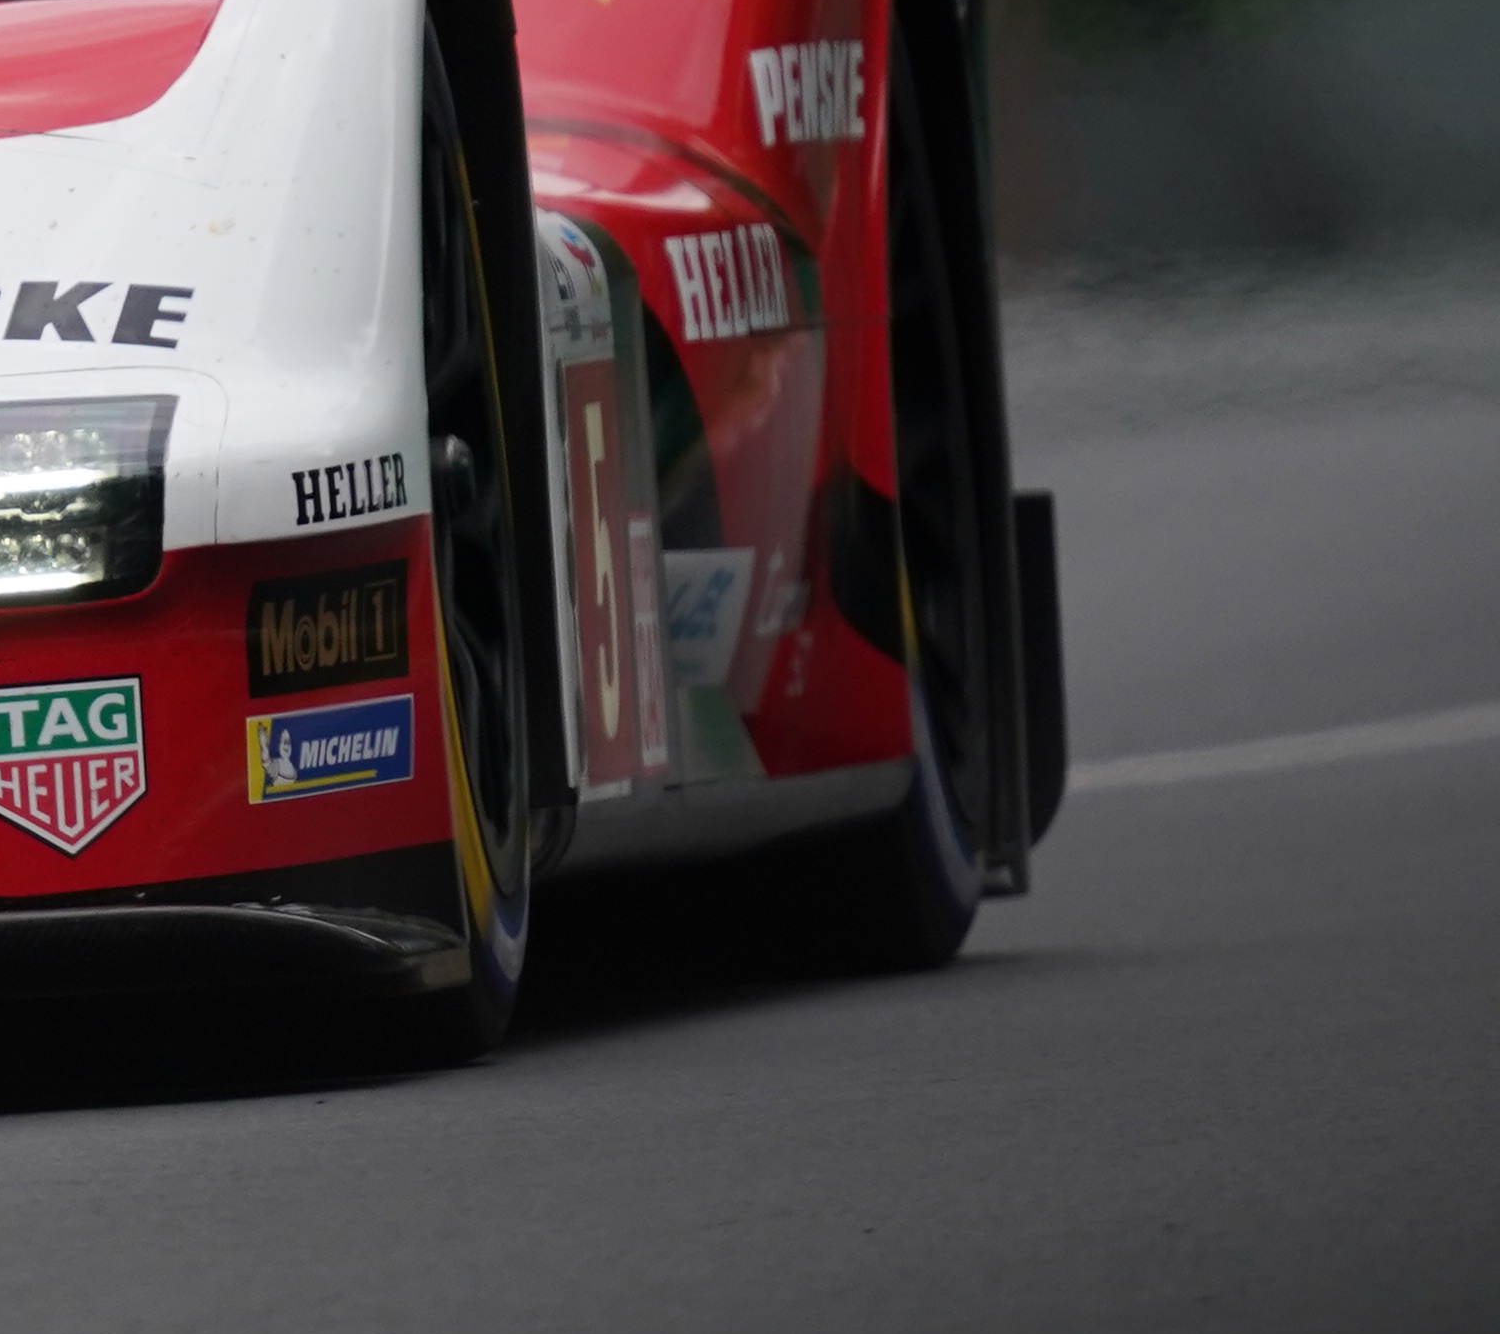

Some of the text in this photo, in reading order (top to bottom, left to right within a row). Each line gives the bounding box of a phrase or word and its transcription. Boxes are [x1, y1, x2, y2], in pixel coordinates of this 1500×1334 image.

[749, 38, 866, 148] PENSKE
[664, 222, 790, 342] HELLER
[292, 452, 408, 525] HELLER
[584, 400, 620, 741] 5
[260, 588, 388, 677] Mobil 1
[299, 725, 400, 771] MICHELIN
